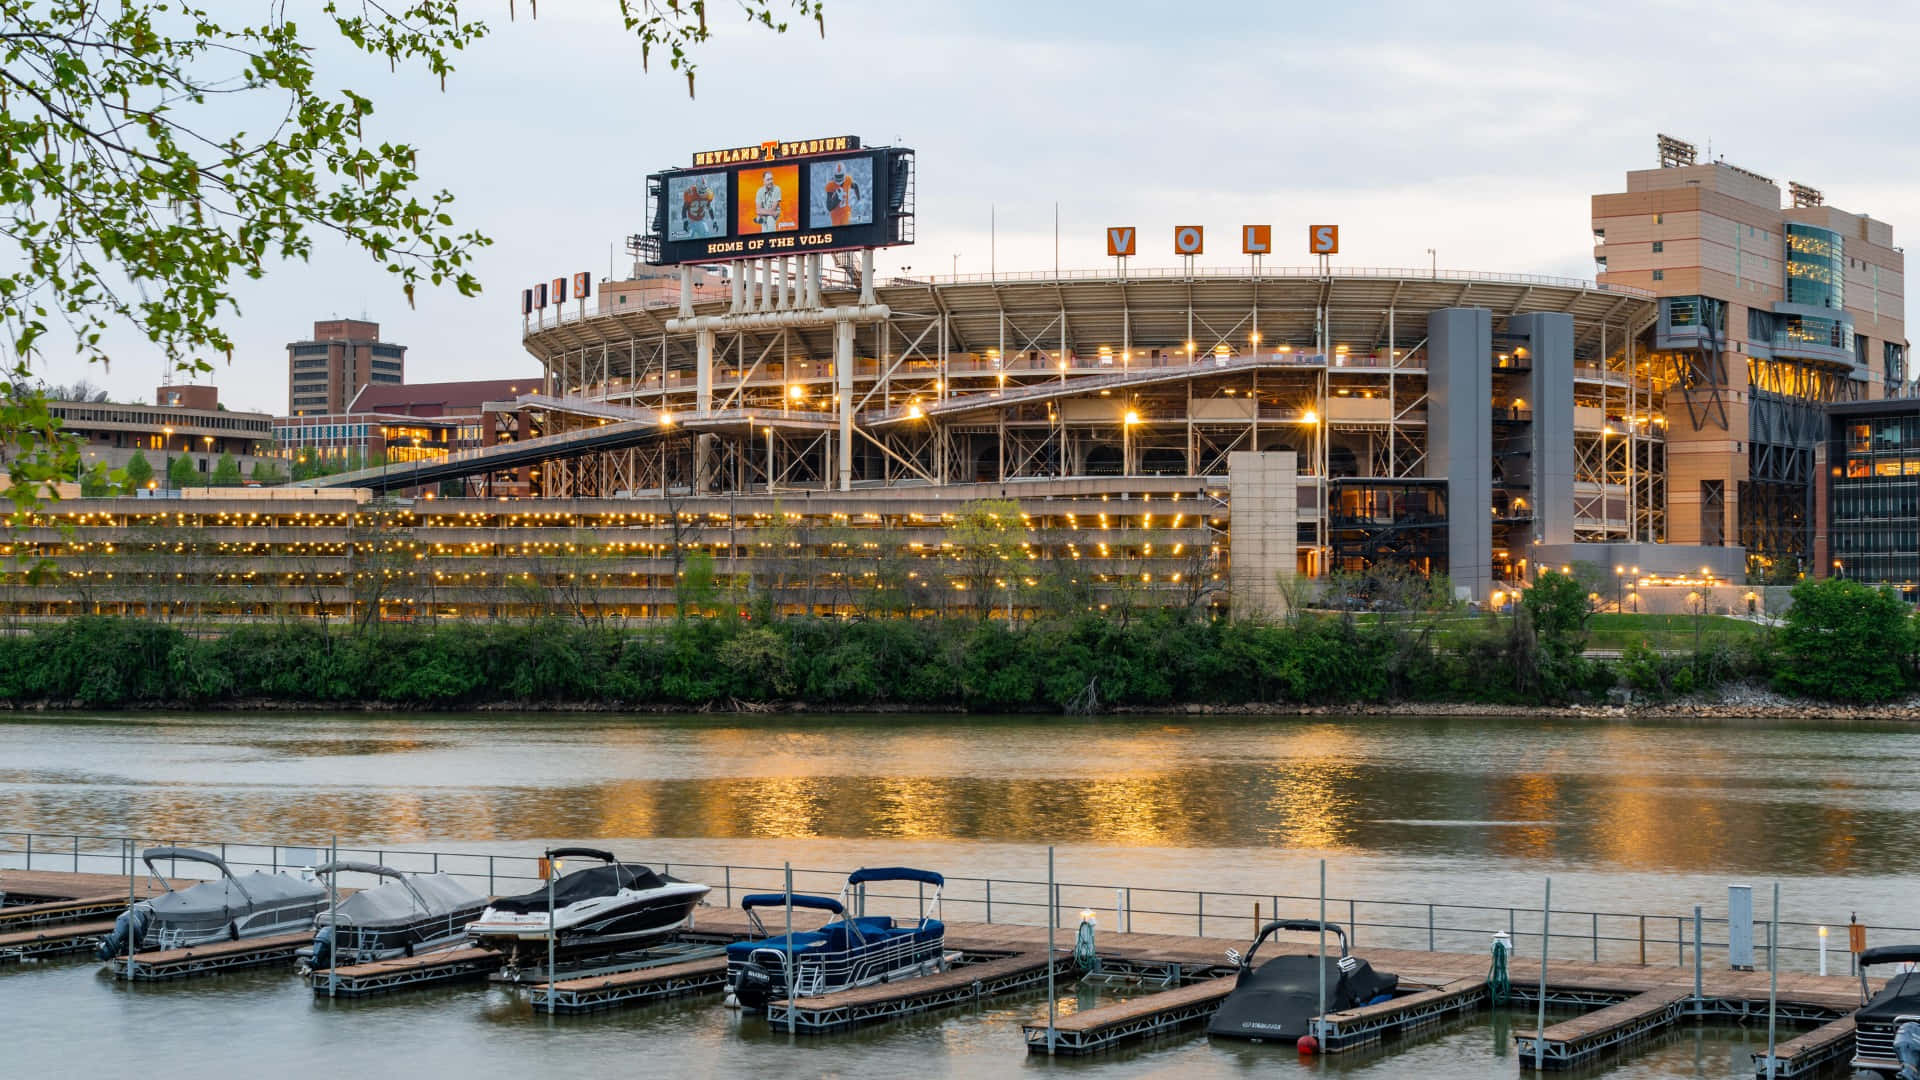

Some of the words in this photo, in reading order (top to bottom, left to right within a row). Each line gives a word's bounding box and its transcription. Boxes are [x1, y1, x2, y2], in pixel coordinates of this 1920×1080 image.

[696, 147, 759, 165] NEYLAND
[761, 140, 778, 161] T
[781, 137, 846, 156] STADIUM
[708, 241, 743, 253] HOME
[748, 239, 764, 250] OF
[769, 236, 795, 248] THE
[800, 233, 833, 246] VOLS
